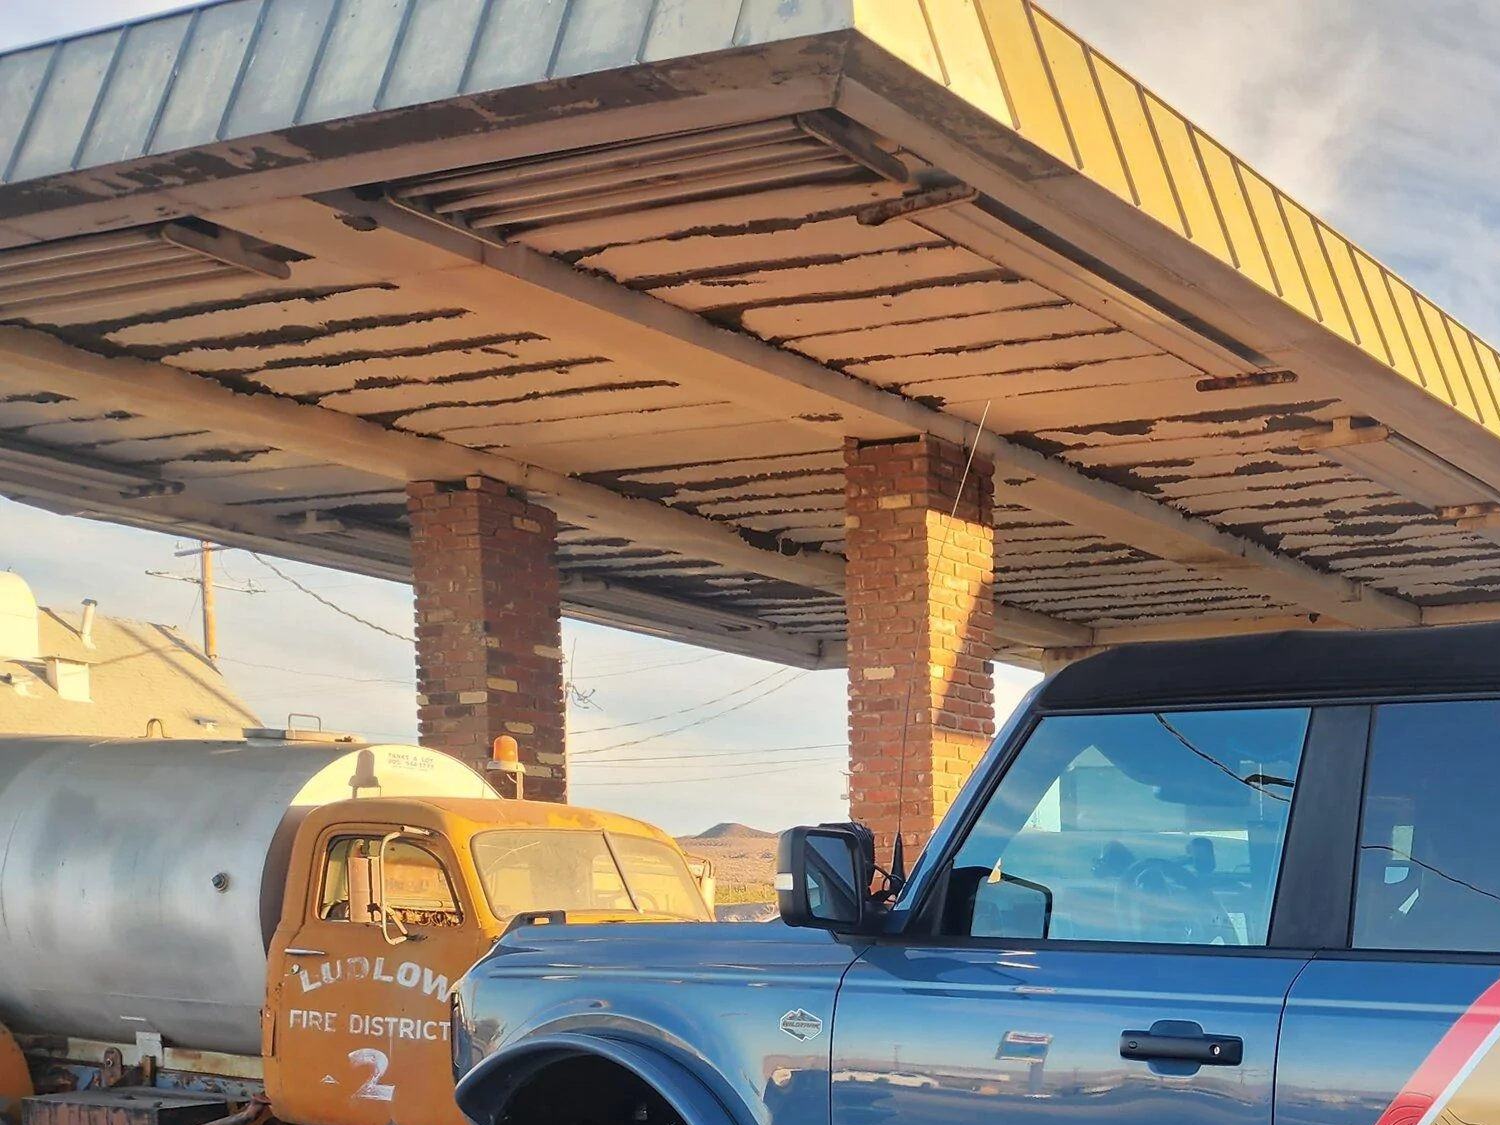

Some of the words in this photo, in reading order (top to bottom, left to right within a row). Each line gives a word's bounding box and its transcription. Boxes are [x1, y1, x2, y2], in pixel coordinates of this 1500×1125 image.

[299, 956, 453, 1003] LUDLOW
[289, 1009, 337, 1033] FIRE
[350, 1013, 451, 1041] DISTRICT
[348, 1048, 395, 1101] 2
